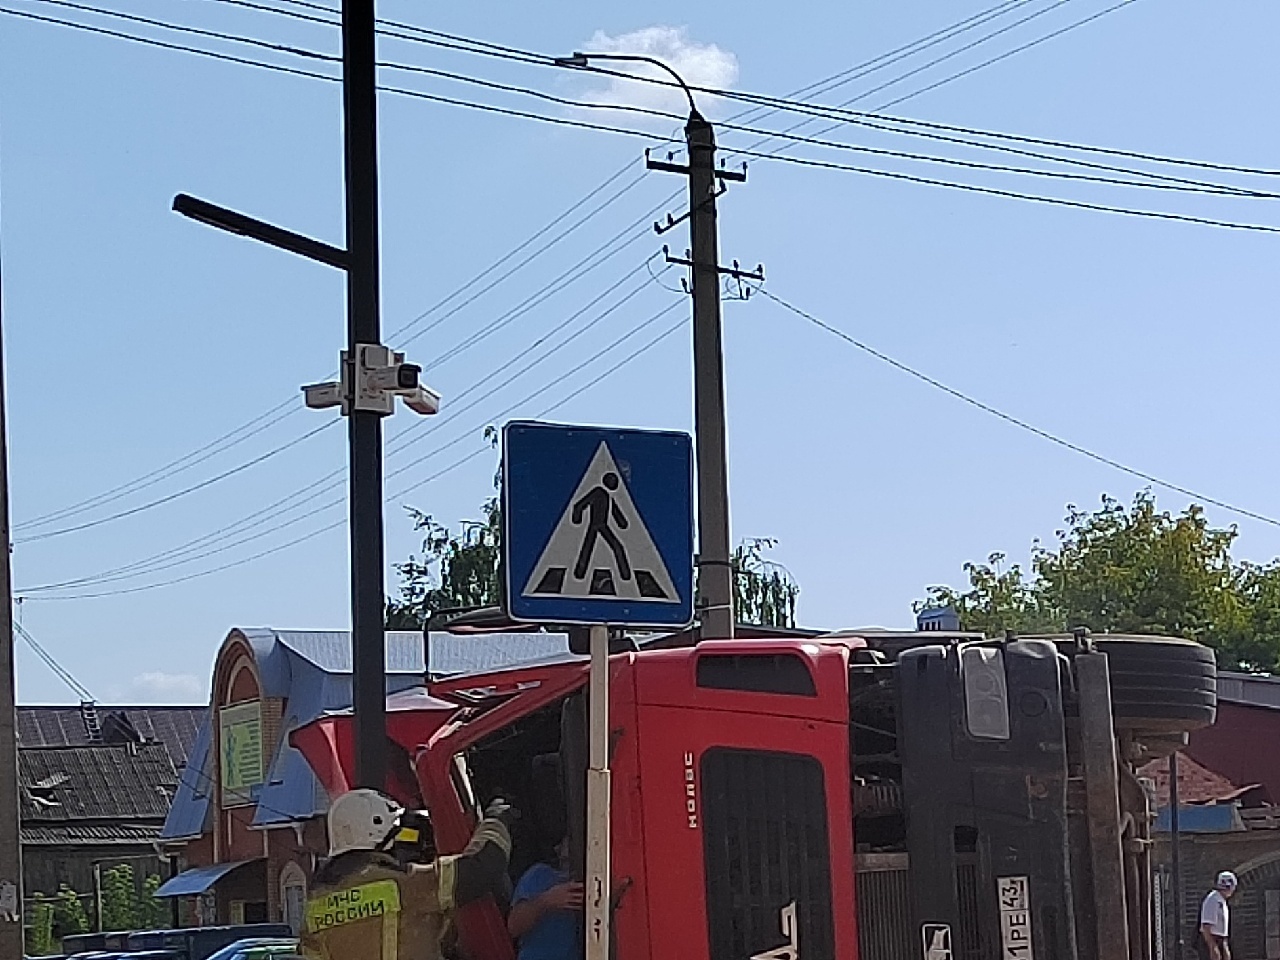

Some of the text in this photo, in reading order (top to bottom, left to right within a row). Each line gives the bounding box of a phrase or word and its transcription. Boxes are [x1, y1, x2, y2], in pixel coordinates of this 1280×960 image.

[327, 889, 361, 910] МЧС
[1002, 886, 1019, 908] 43
[314, 899, 385, 930] РОССИИ
